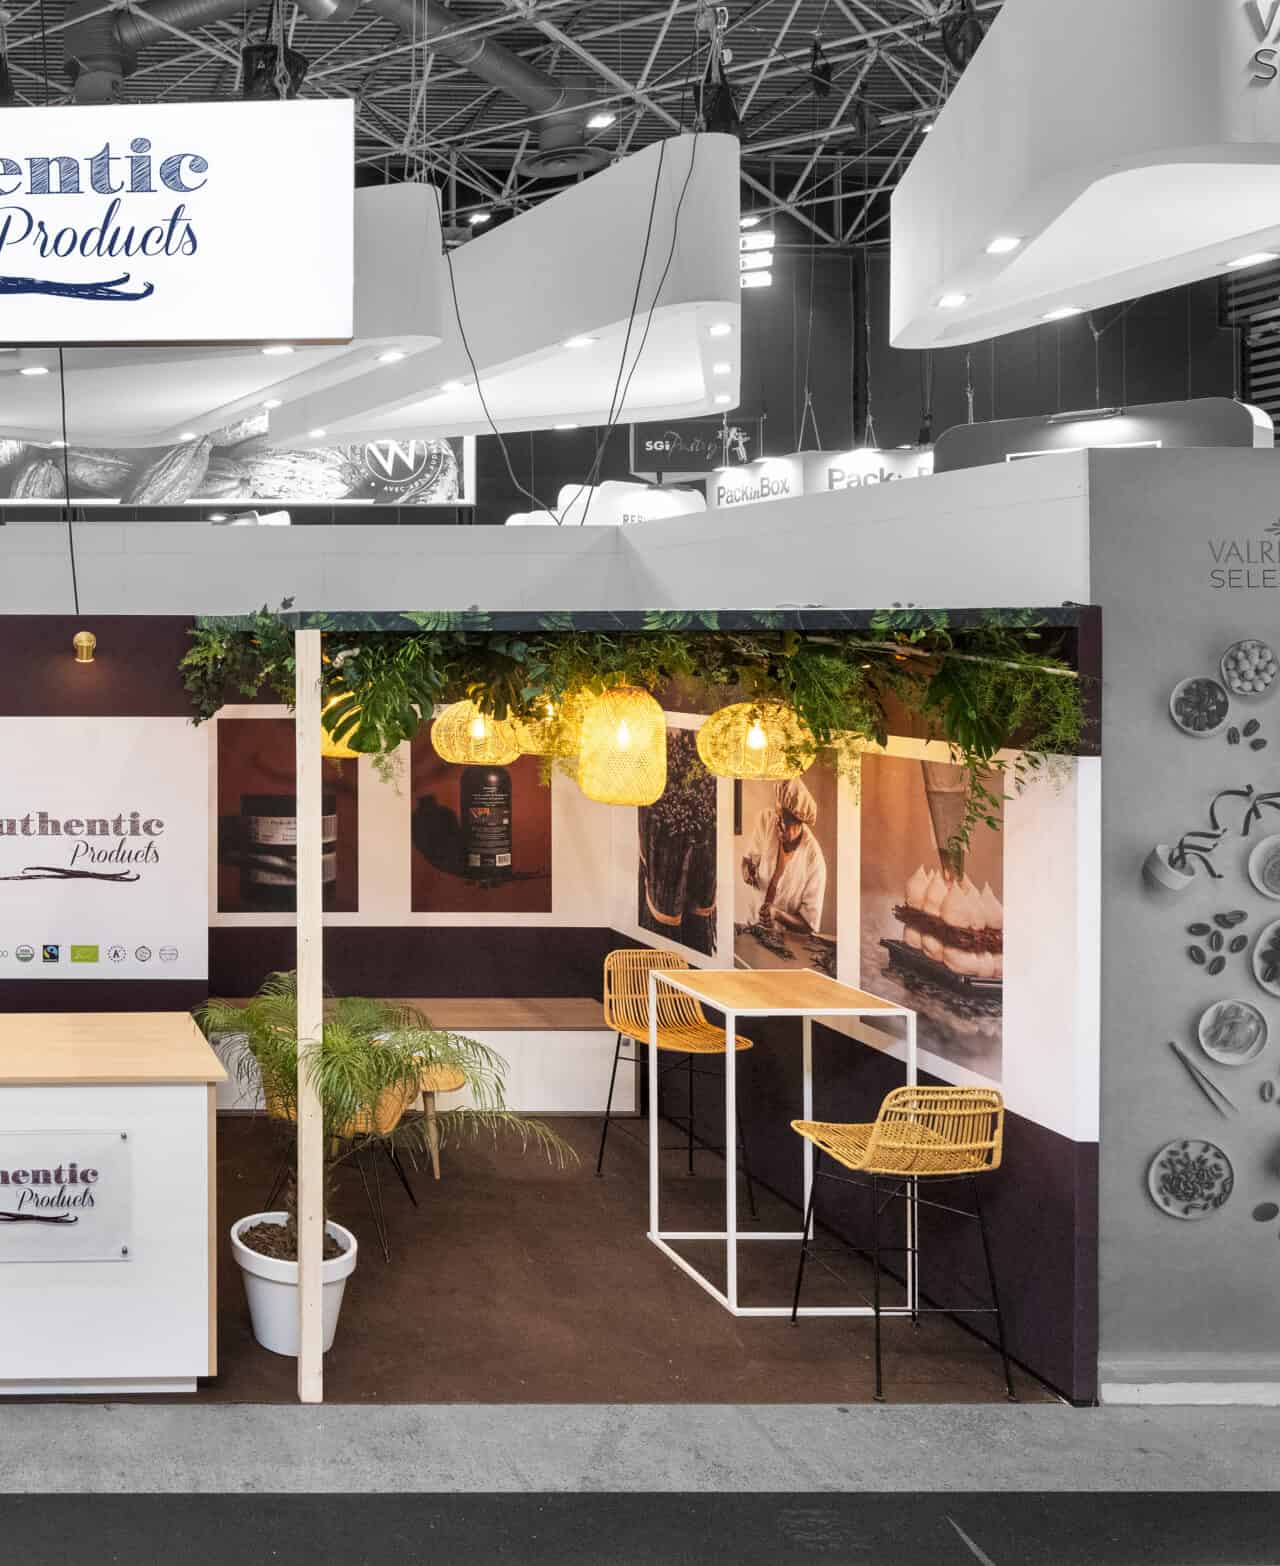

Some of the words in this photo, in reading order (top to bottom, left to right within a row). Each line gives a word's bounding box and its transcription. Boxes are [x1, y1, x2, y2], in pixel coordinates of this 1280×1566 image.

[828, 467, 902, 490] Pack
[1208, 540, 1280, 564] VALR
[70, 838, 160, 866] Products
[17, 1185, 96, 1211] Products
